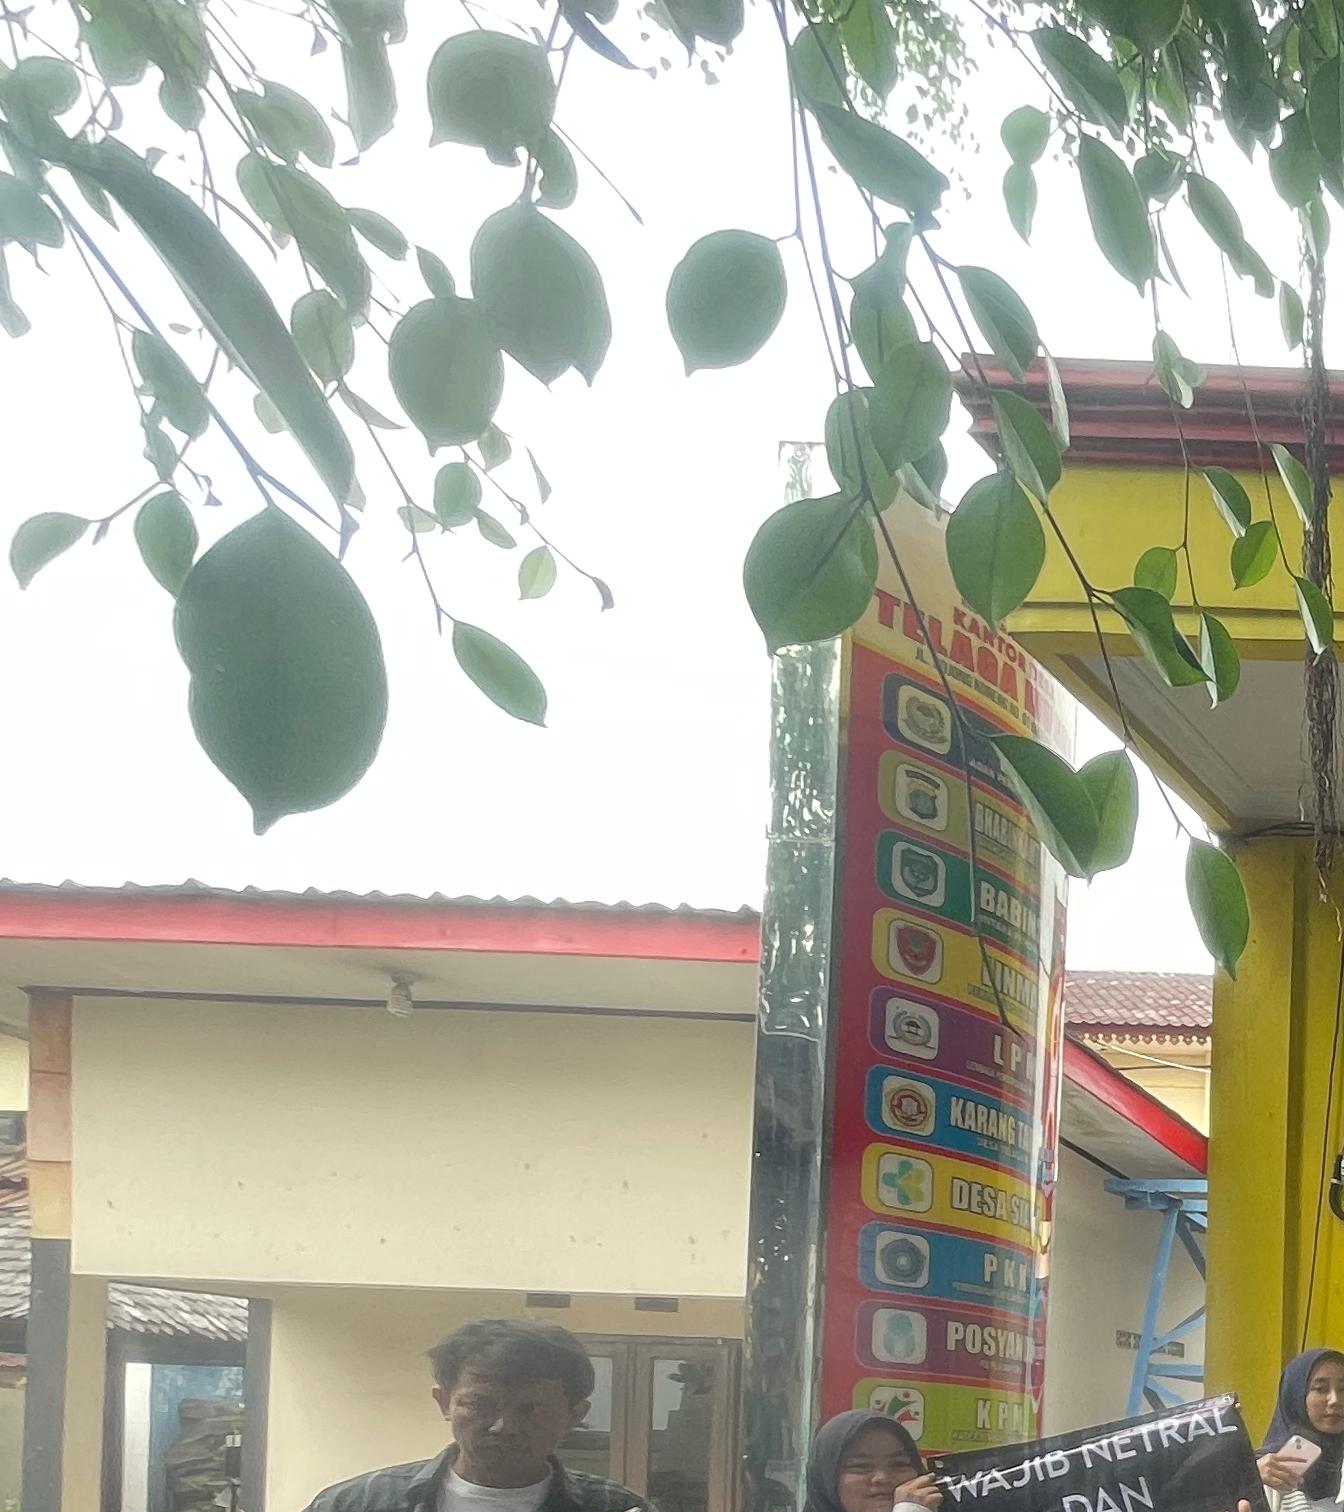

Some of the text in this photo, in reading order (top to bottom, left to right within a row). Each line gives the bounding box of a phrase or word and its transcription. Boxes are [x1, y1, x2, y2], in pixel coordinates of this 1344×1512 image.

[950, 1096, 1016, 1145] KARANG
[951, 1177, 1009, 1223] DESA
[944, 1407, 1238, 1502] WAJIB NETRAL
